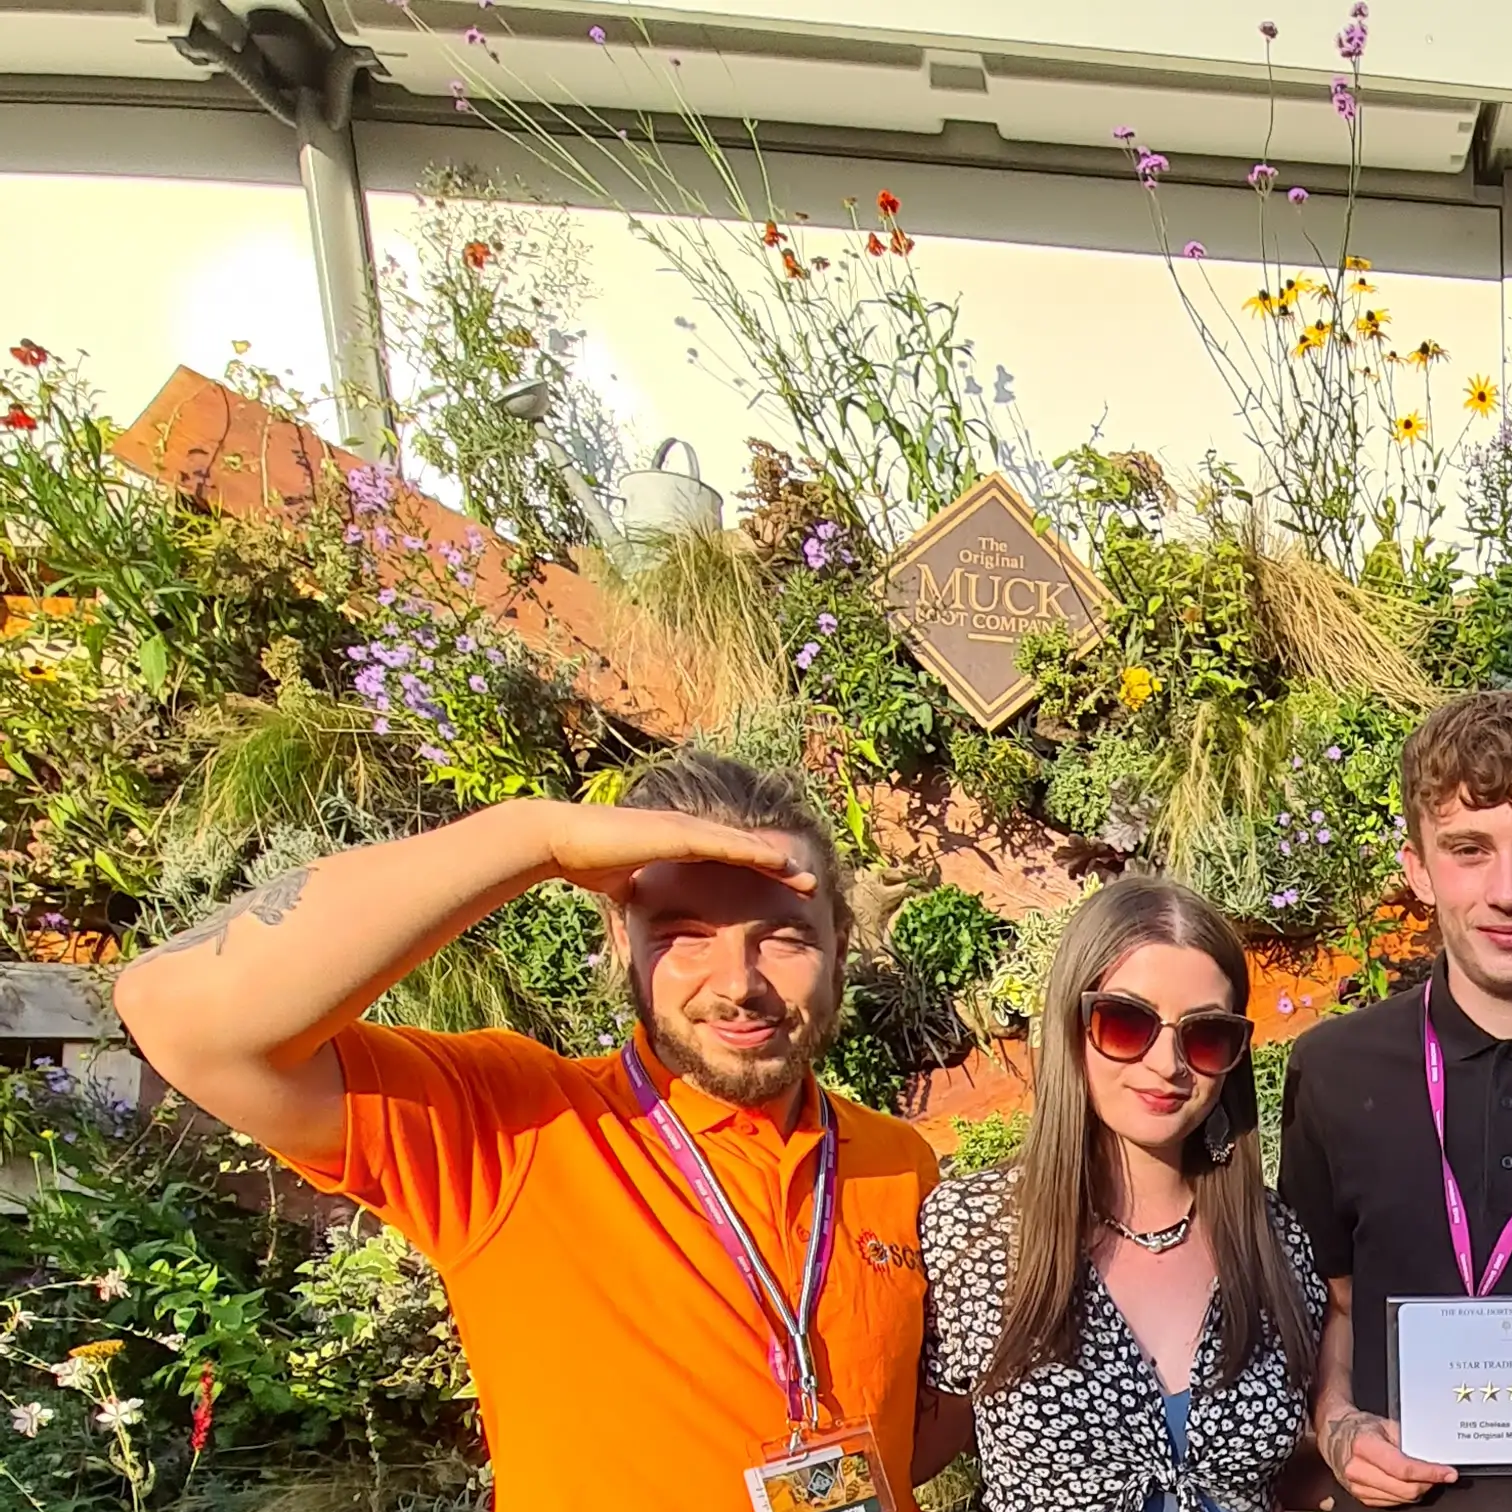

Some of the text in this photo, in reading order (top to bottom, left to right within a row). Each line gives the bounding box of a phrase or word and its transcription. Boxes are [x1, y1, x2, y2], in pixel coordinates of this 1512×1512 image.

[978, 537, 1008, 553] The
[959, 549, 1025, 570] Original
[916, 563, 1070, 621] MUCK
[889, 1243, 921, 1272] SG
[1440, 1308, 1456, 1317] THE
[1458, 1308, 1484, 1316] ROYAL
[1456, 1361, 1480, 1370] STAR
[1459, 1420, 1478, 1429] RHS
[1479, 1420, 1510, 1428] Chelsea
[1457, 1432, 1471, 1440] The
[1473, 1431, 1504, 1441] Original
